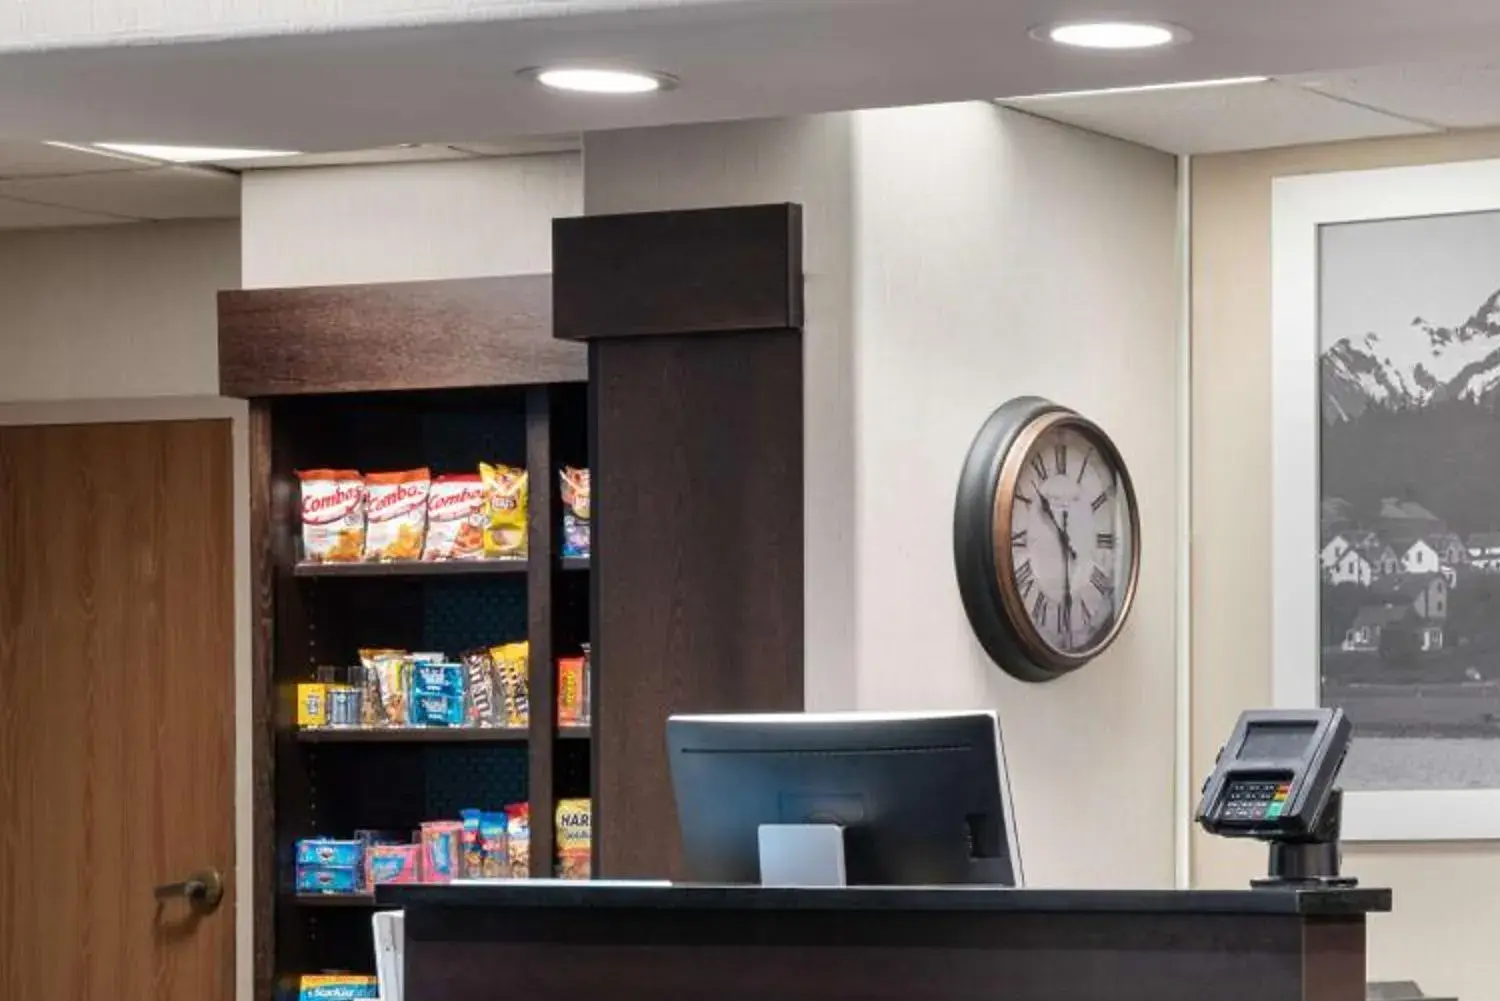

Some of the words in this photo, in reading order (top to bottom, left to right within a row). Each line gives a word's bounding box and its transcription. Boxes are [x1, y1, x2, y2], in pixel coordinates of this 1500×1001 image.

[302, 485, 363, 514] Combos
[428, 487, 484, 512] Combo
[561, 813, 592, 826] HAR
